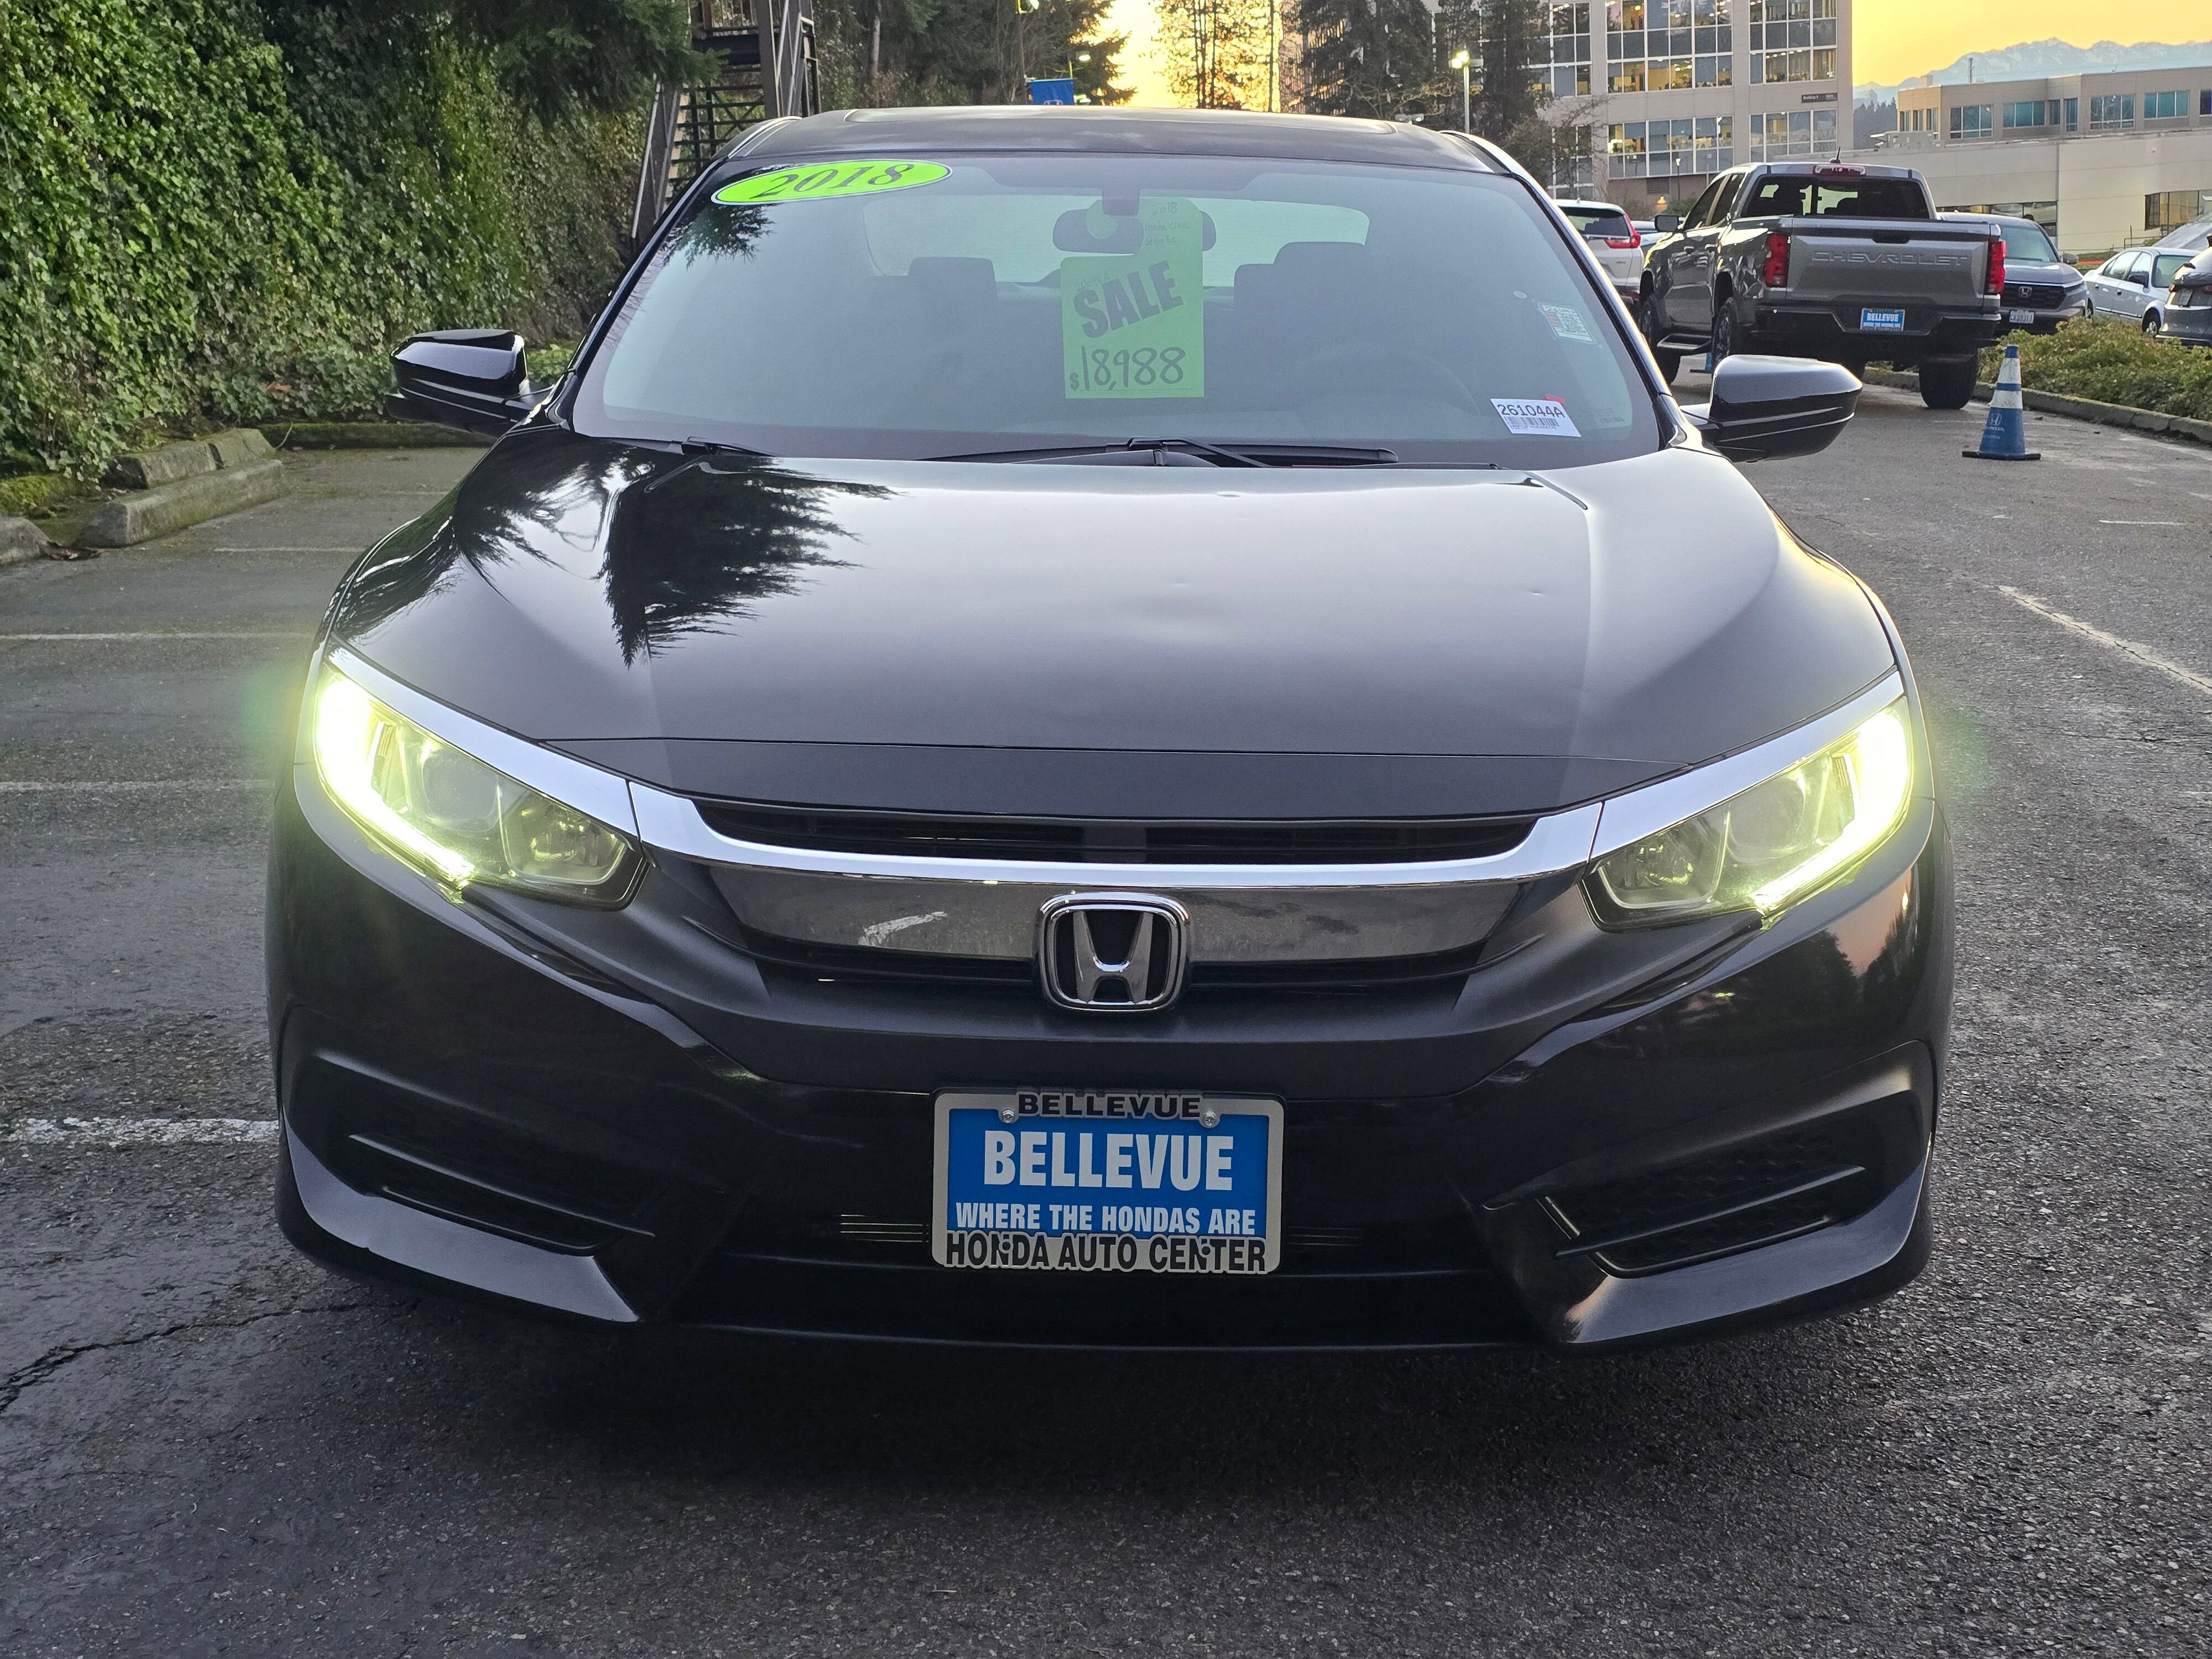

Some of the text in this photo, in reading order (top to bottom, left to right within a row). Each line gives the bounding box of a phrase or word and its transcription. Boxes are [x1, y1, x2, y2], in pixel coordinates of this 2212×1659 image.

[749, 164, 915, 200] 2018
[1151, 201, 1177, 216] 2018
[1812, 252, 1968, 266] CHEVROLET
[1073, 259, 1184, 338] SALE
[1866, 312, 1899, 322] BELLEVUE
[1070, 346, 1186, 391] $18,988
[1497, 404, 1566, 418] 261044A
[1018, 1094, 1201, 1118] BELLEVUE
[984, 1130, 1234, 1191] BELLEVUE
[956, 1202, 1256, 1235] WHERE THE HONDAS ARE
[946, 1233, 1266, 1272] HONDA AUTO CENTER
